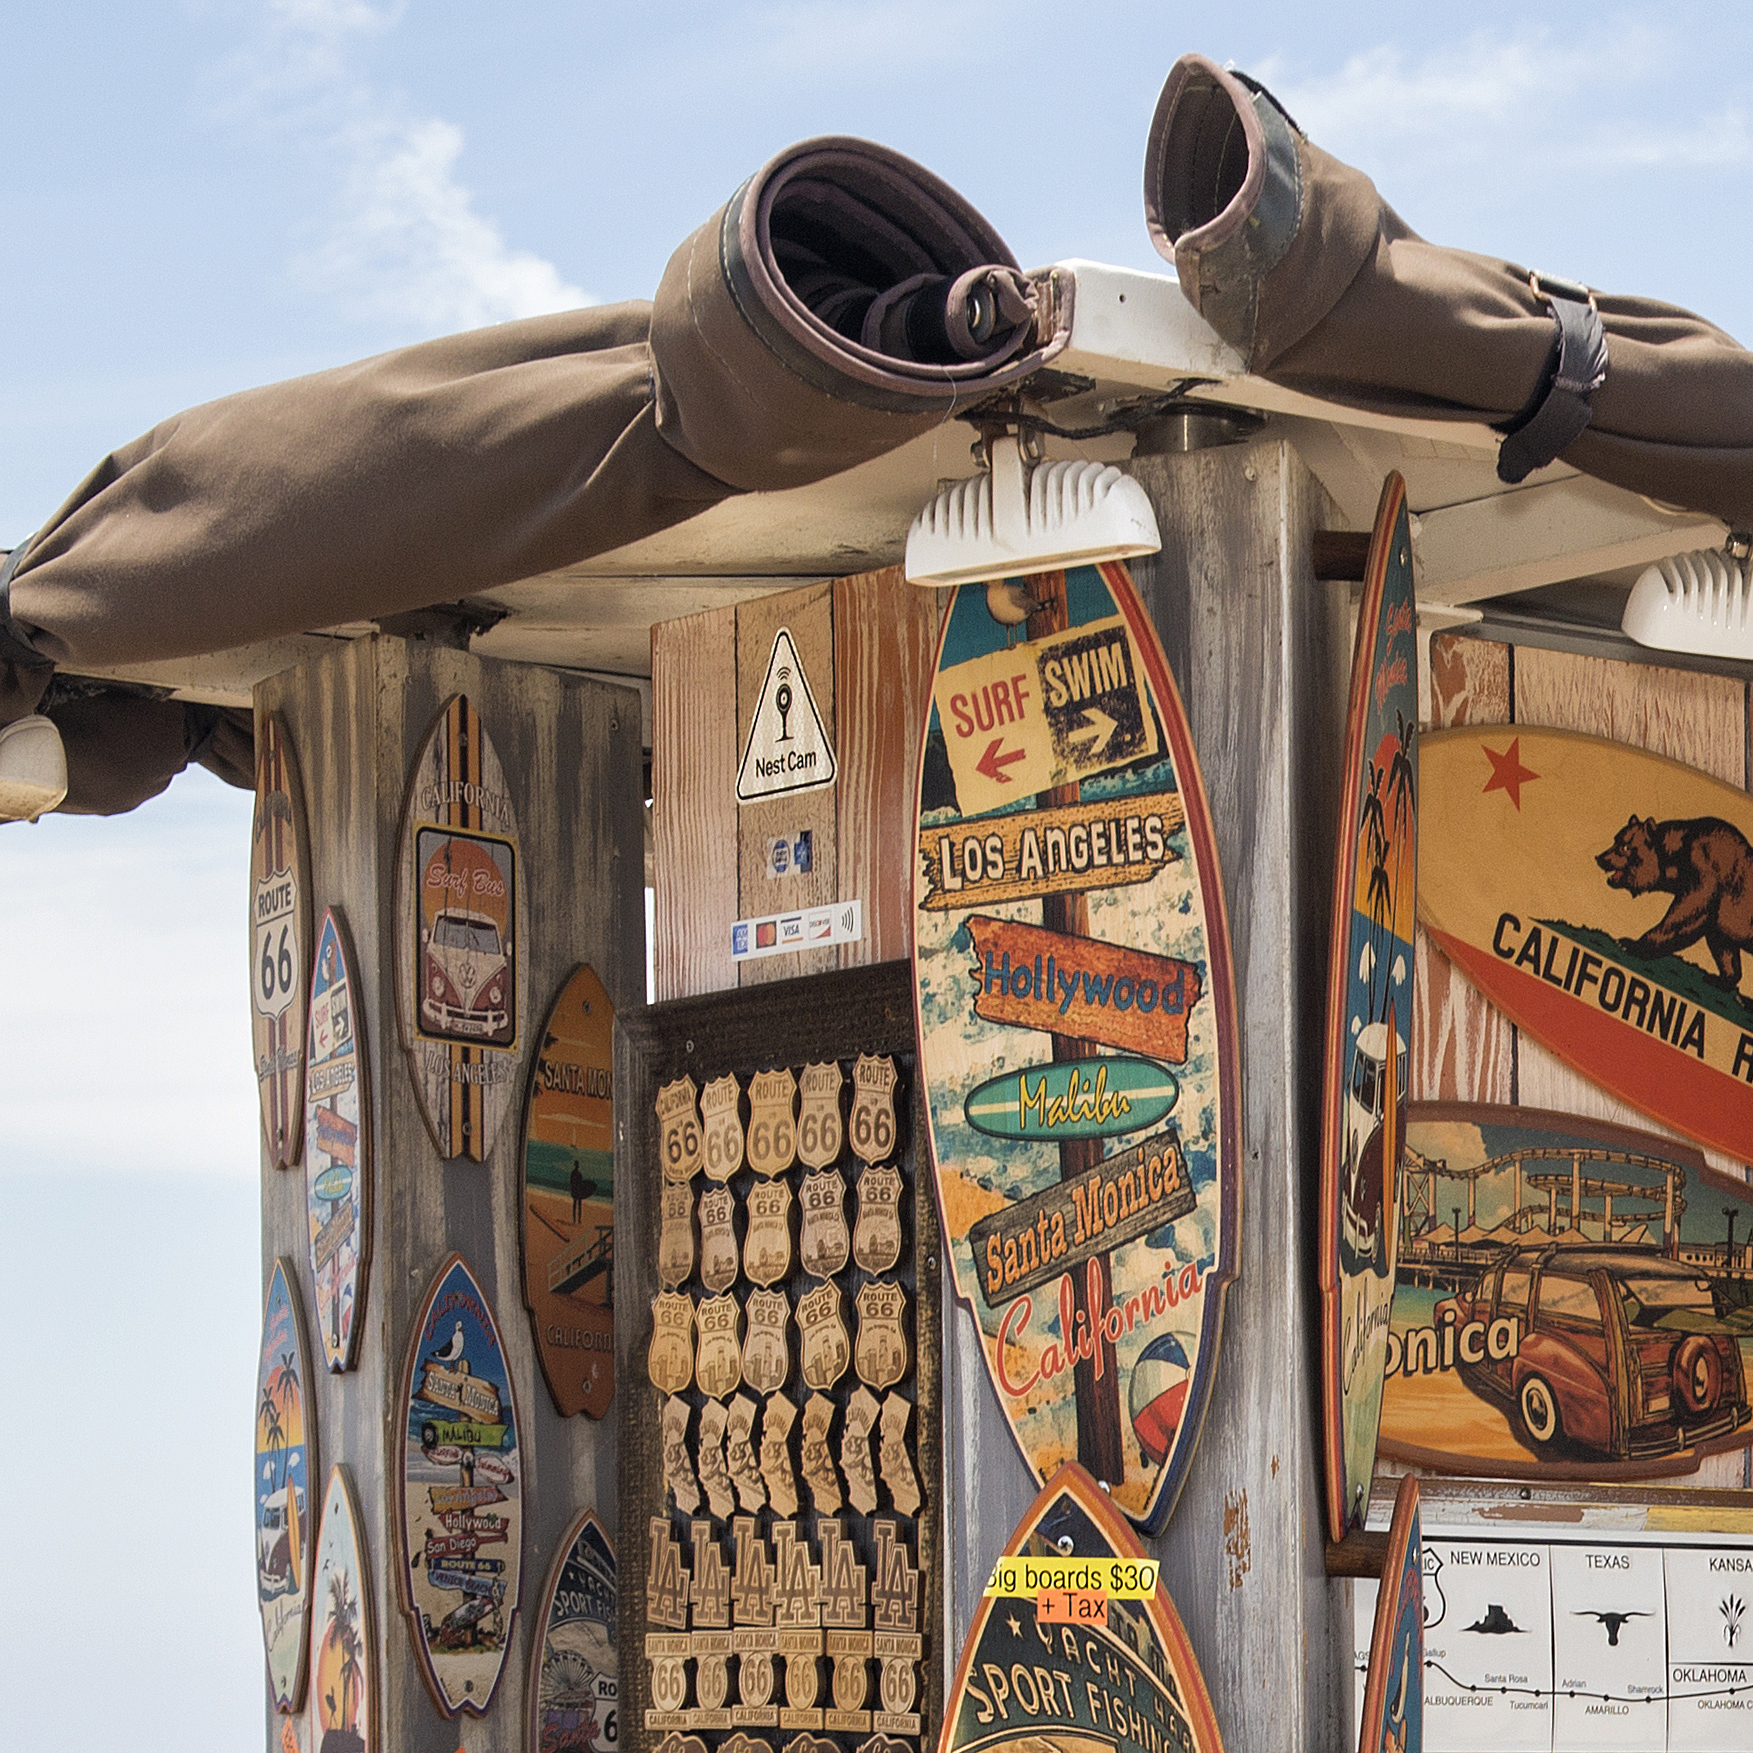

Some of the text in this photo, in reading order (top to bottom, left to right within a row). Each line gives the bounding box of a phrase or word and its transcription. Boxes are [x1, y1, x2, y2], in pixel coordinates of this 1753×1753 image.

[949, 641, 1128, 739] SURF SWIM
[755, 750, 817, 778] Nest Cam
[421, 780, 510, 831] CALIFORNIA
[939, 834, 1005, 893] LOS
[427, 863, 467, 898] Surf
[258, 882, 292, 917] ROUTE
[260, 923, 293, 1000] 66
[982, 950, 1186, 1017] Hollywood
[1492, 911, 1706, 1060] CALIFORNIA
[545, 1060, 587, 1092] SANTA
[805, 1071, 837, 1093] ROUTE
[859, 1064, 891, 1087] ROUTE
[705, 1084, 734, 1111] ROUTE
[754, 1082, 790, 1100] ROUTE
[1017, 1063, 1132, 1131] Malibu
[801, 1112, 838, 1152] 66
[854, 1104, 892, 1149] 66
[666, 1120, 699, 1165] 66
[706, 1123, 740, 1169] 66
[751, 1120, 792, 1161] 66
[806, 1179, 838, 1193] ROUTE
[863, 1174, 896, 1187] ROUTE
[865, 1186, 892, 1202] 66
[755, 1199, 782, 1216] 66
[808, 1190, 836, 1210] 66
[986, 1146, 1182, 1295] Santa Monica
[863, 1292, 898, 1303] ROUTE
[865, 1302, 894, 1319] 66
[703, 1312, 730, 1331] 66
[804, 1302, 831, 1326] 66
[995, 1256, 1205, 1399] California
[440, 1423, 483, 1443] MALIBU
[427, 1536, 477, 1554] San Diego
[1449, 1550, 1485, 1567] NEW
[1486, 1551, 1541, 1568] MEXICO
[1584, 1553, 1631, 1570] TEXAS
[986, 1563, 1157, 1594] Big boards $30
[1062, 1592, 1106, 1619] Tax
[886, 1664, 910, 1703] 66
[1672, 1668, 1748, 1684] OKLAHOMA
[966, 1662, 1076, 1724] SPORT
[1423, 1695, 1494, 1707] ALBUQUERQUE
[1697, 1699, 1747, 1711] OKLAHOMA
[875, 1716, 918, 1732] CALIFORNIA
[1584, 1705, 1630, 1716] AMARILLO
